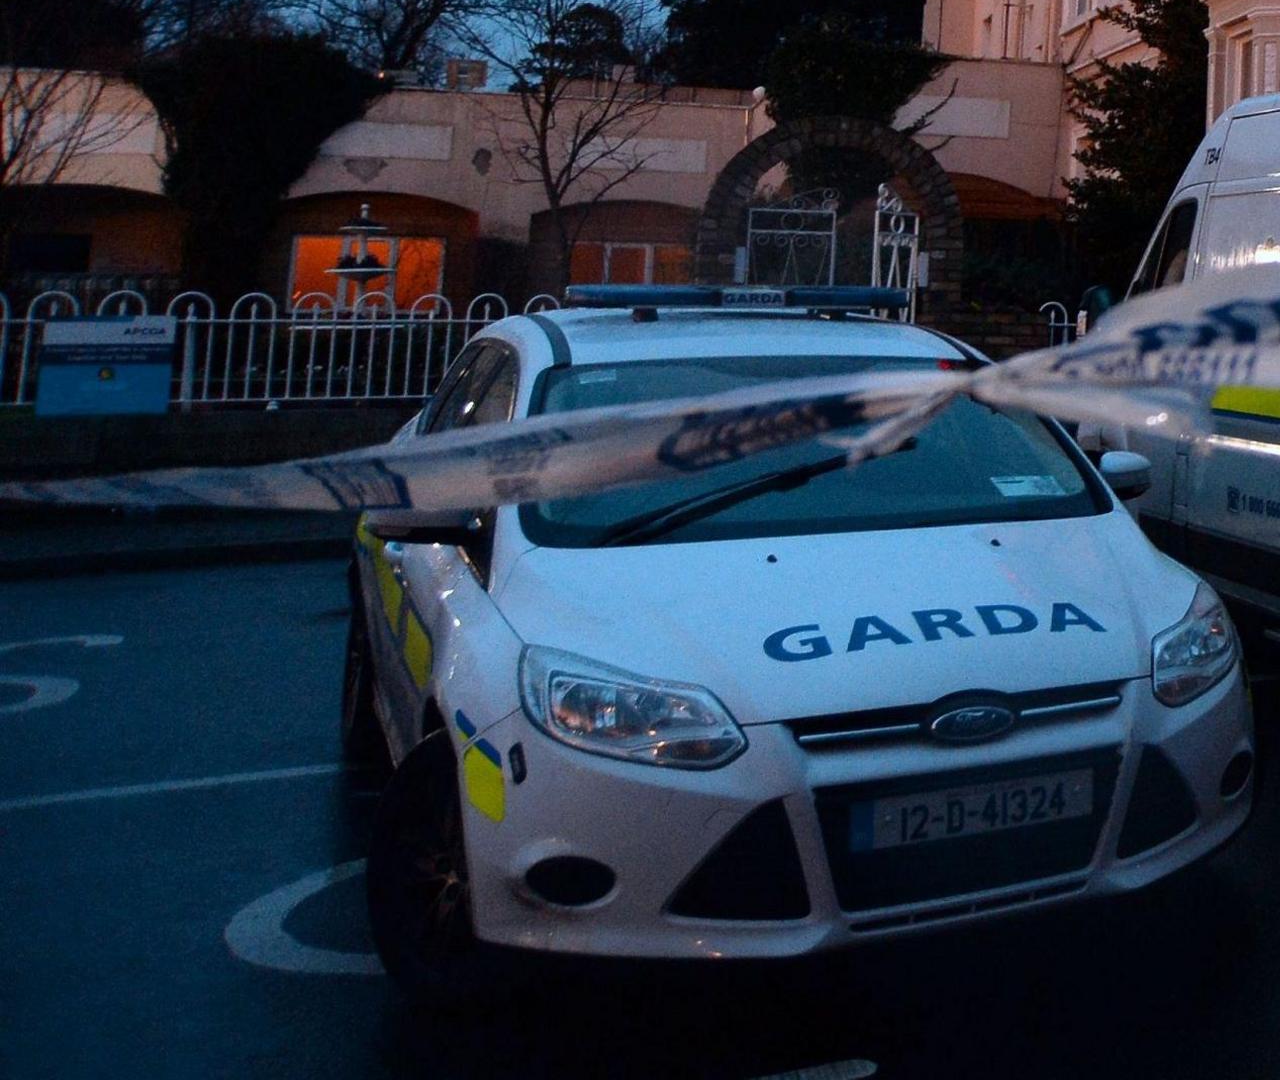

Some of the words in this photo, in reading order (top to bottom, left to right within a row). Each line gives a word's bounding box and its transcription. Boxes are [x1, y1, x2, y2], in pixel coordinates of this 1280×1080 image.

[724, 293, 782, 304] GARDA
[763, 601, 1107, 663] GARDA
[900, 782, 1067, 841] 12-D-41324
